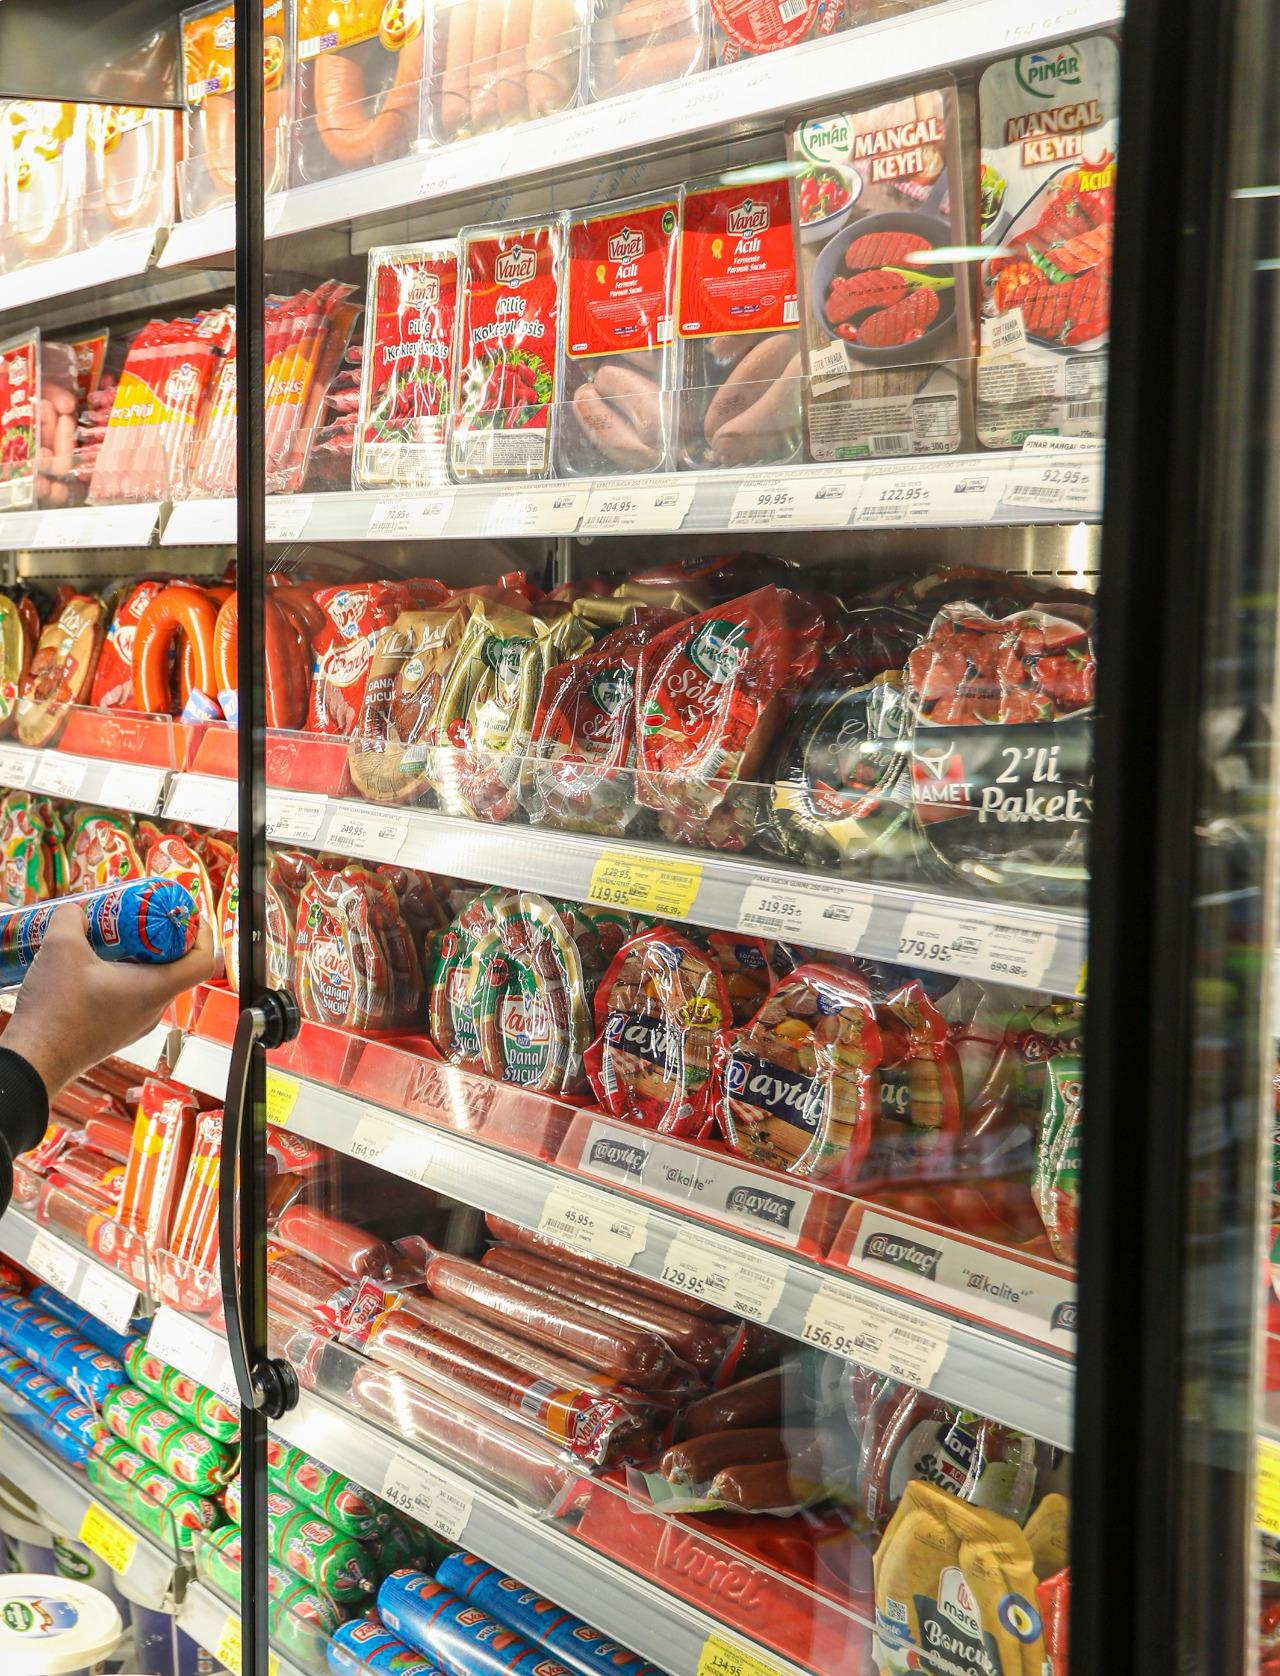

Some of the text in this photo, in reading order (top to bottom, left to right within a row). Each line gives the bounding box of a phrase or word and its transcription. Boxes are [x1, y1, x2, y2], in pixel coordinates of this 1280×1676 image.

[1029, 57, 1079, 83] PINAR
[1008, 100, 1104, 142] MANGAL
[809, 125, 849, 150] PINAR
[854, 117, 944, 160] MANGAL
[729, 209, 766, 231] Vanet
[610, 238, 642, 258] Vanet
[497, 257, 533, 280] Vanet
[499, 297, 527, 316] Piliç
[473, 320, 513, 344] Kokteyl
[930, 441, 945, 452] 300
[369, 677, 395, 691] DANA
[977, 786, 1084, 824] Paket
[322, 995, 349, 1015] Sucuk
[457, 1017, 478, 1035] Dan
[451, 1035, 480, 1051] Sucu
[943, 1600, 979, 1631] mare
